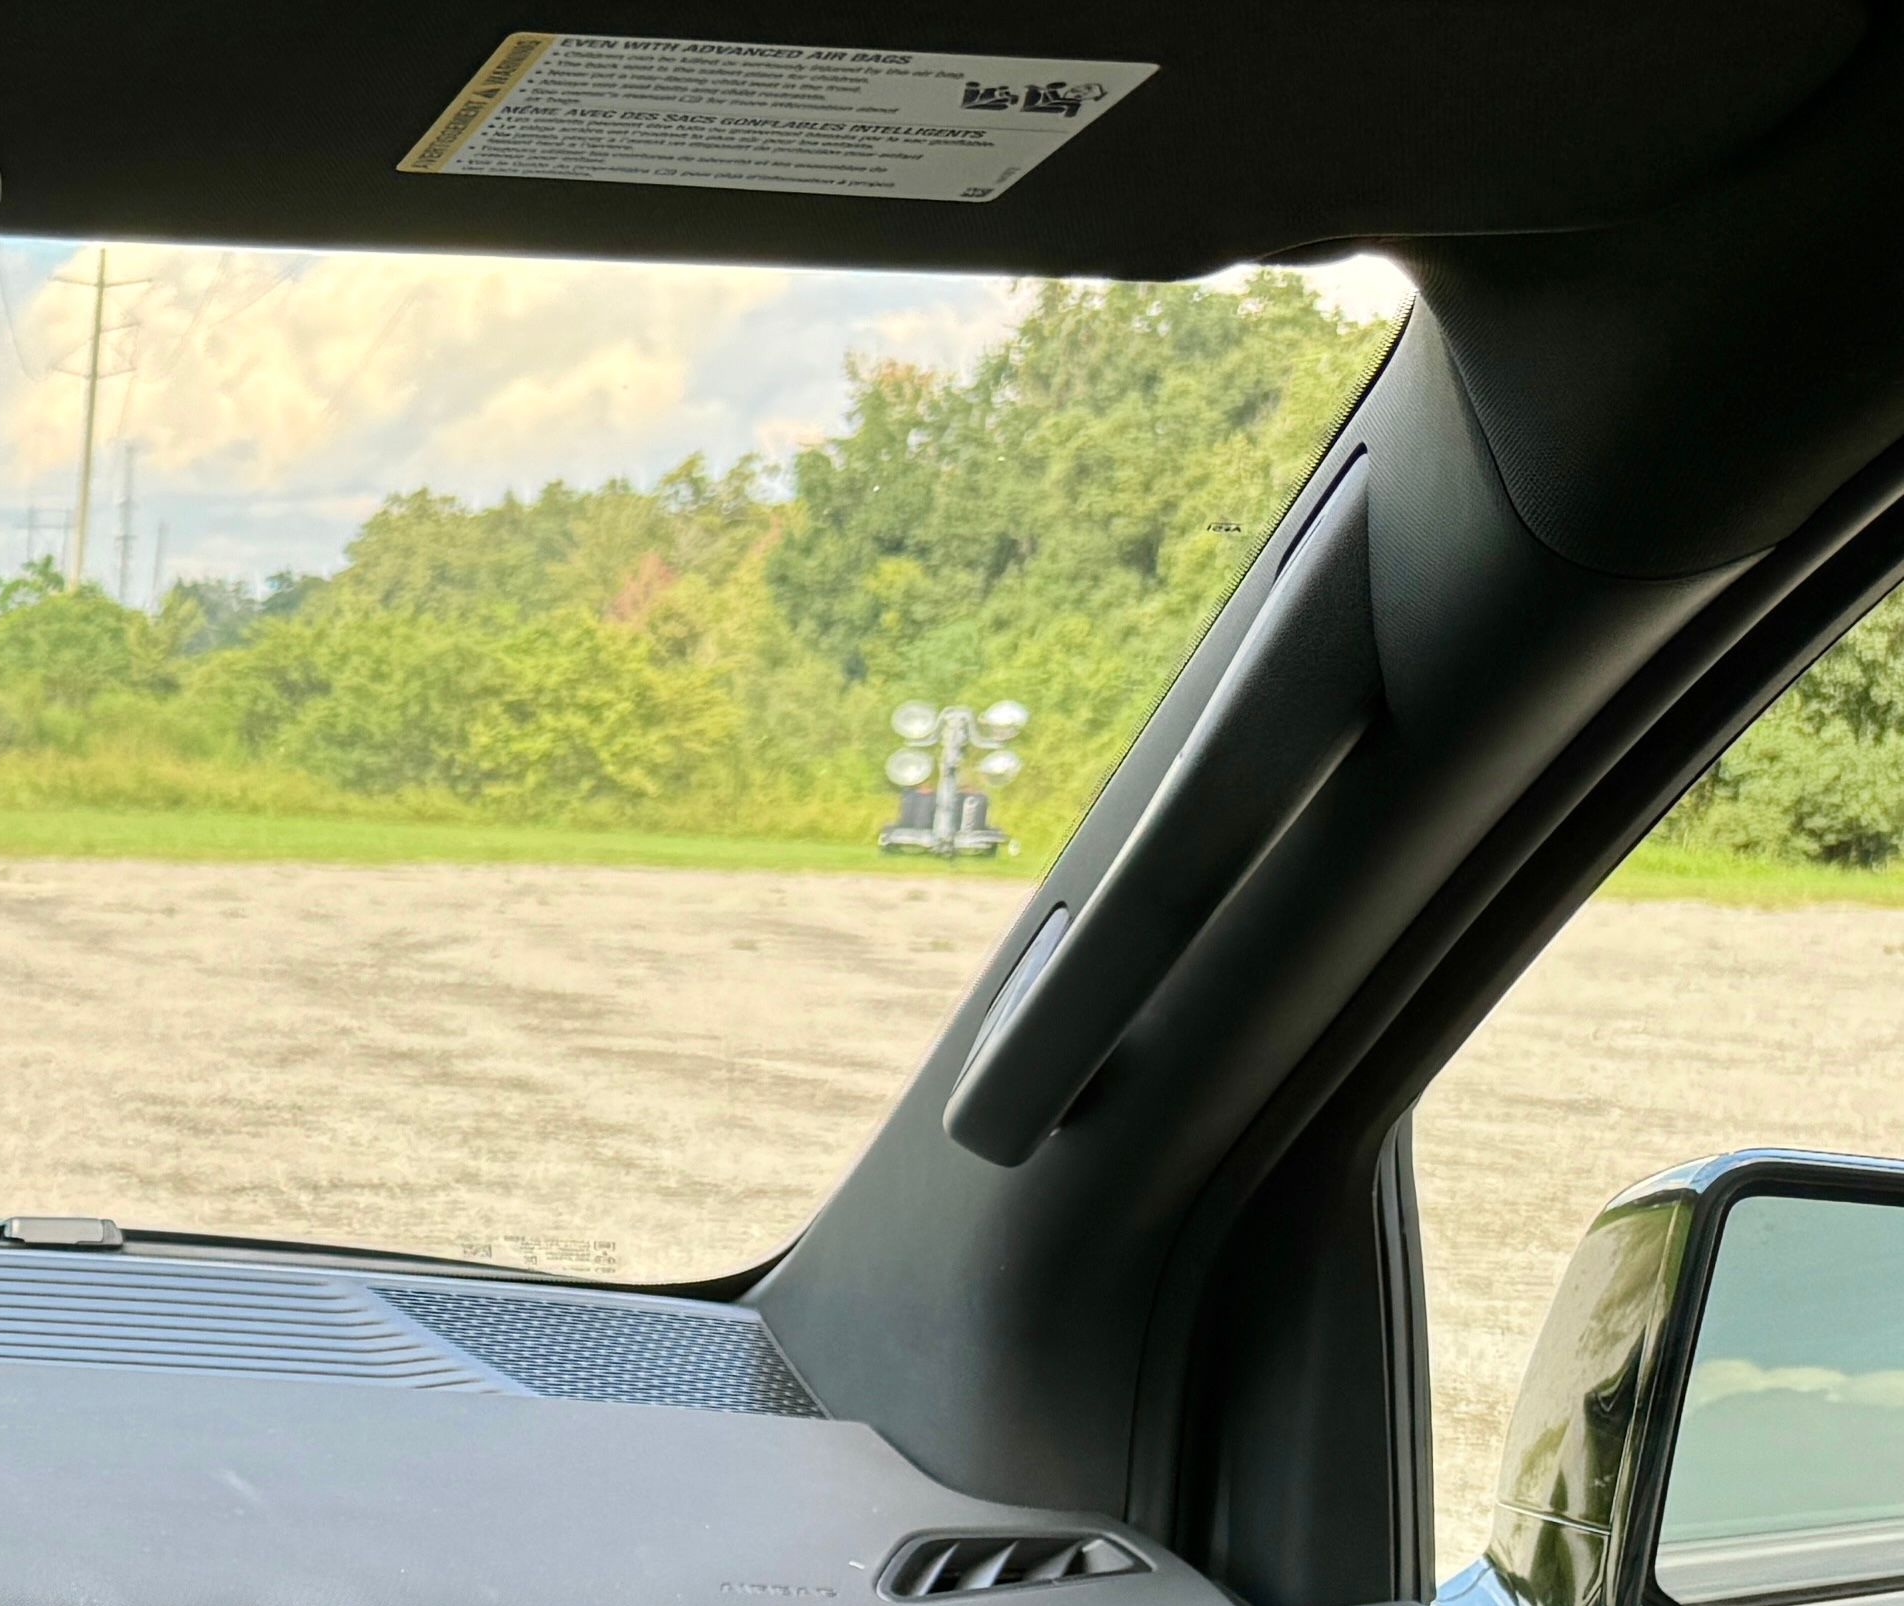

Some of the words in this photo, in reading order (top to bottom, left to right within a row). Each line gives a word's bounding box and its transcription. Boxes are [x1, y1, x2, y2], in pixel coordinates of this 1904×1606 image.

[559, 37, 619, 49] EVEN
[621, 40, 680, 51] WITH
[682, 44, 804, 58] ADVANCED
[805, 50, 847, 60] AIR
[849, 52, 913, 64] BAGS
[563, 108, 617, 118] AVEC
[618, 111, 661, 120] DES
[661, 113, 718, 123] SACS
[849, 125, 987, 139] INTELLIGENTS
